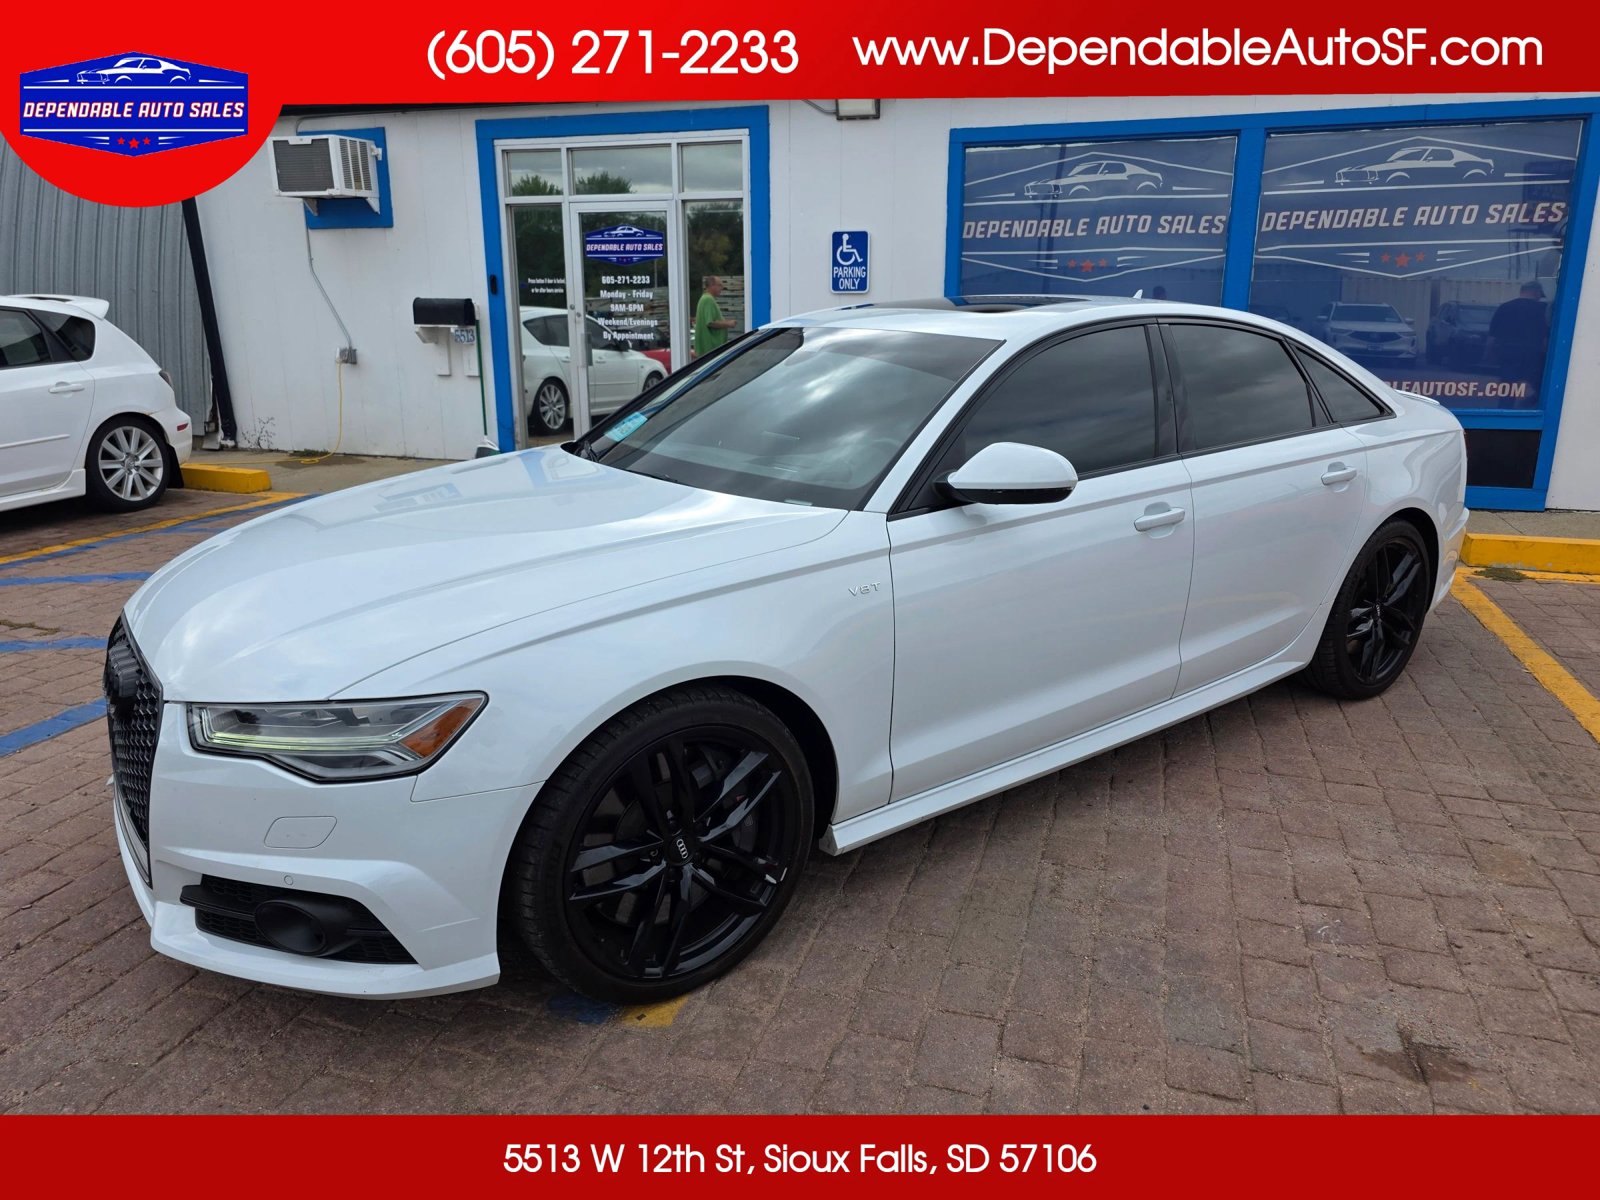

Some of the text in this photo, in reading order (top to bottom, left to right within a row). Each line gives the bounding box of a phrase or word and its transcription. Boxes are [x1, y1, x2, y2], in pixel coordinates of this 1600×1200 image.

[1261, 202, 1567, 232] DEPENDABLE AUTO SALES
[962, 215, 1227, 238] DEPENDABLE AUTO SALES
[586, 243, 664, 252] DEPENDABLE AUTO SALES
[833, 266, 867, 278] PARKING
[601, 275, 651, 285] 605-271-2233
[838, 277, 860, 290] ONLY
[600, 289, 626, 299] Monday
[632, 289, 654, 299] Friday
[609, 303, 644, 312] 9AM-6PM
[597, 317, 658, 328] Weekend/Evenings
[454, 328, 476, 344] 5513
[602, 330, 655, 341] By Appointment
